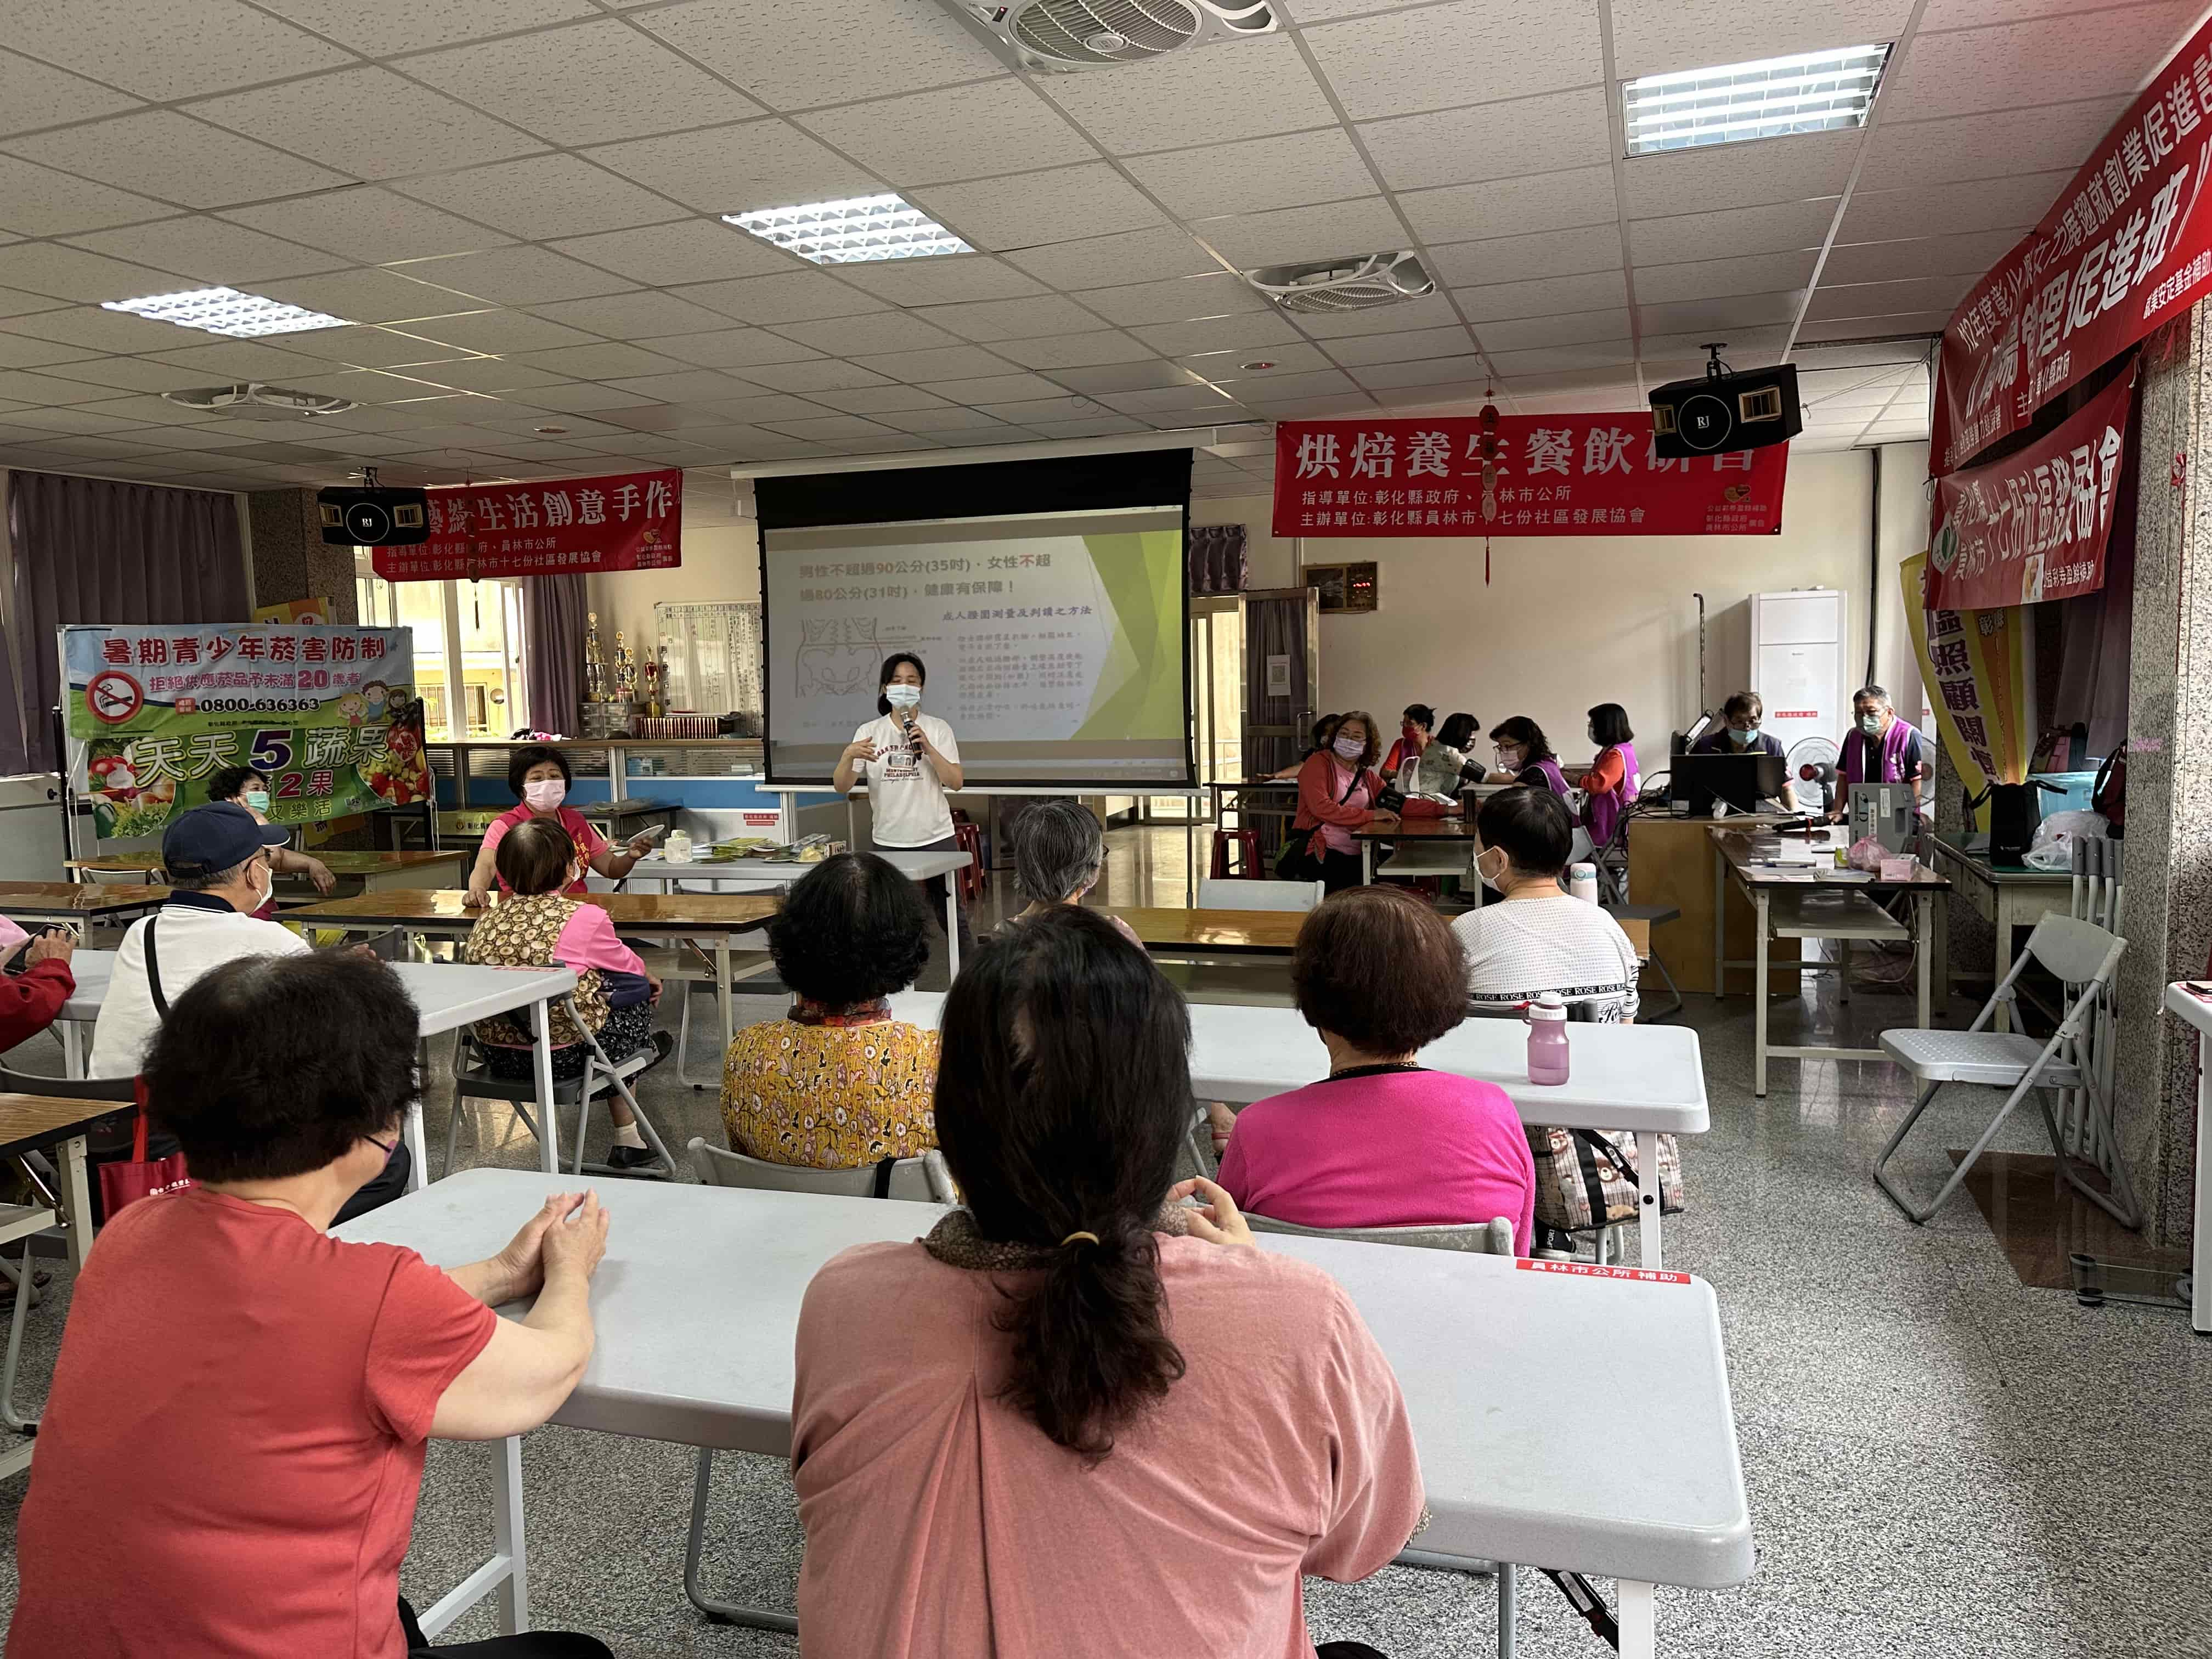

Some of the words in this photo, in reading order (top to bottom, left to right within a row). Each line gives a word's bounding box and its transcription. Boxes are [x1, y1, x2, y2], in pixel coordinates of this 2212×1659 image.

[2143, 248, 2212, 319] 業安定基金補助
[1697, 415, 1710, 428] RJ
[363, 518, 373, 527] RJ
[1300, 507, 1646, 527] 主辦單位:彰化縣員林市七份社區發展協會
[386, 537, 556, 557] 指導單位:彰化縣府、員林市公所
[2044, 560, 2095, 589] 益彩券盈餘補助
[103, 635, 386, 663] 暑期青少年菸害防制
[1925, 582, 1997, 781] 區照顧關懷
[201, 698, 320, 713] 0800-636363
[134, 724, 390, 788] 天天5蔬果
[268, 770, 334, 799] 2果
[1500, 992, 1525, 1000] ROSE
[1526, 991, 1542, 999] ROS
[1575, 986, 1597, 995] ROSE
[1598, 985, 1616, 993] ROSE
[1531, 1261, 1631, 1278] 員林市公所
[1638, 1271, 1678, 1282] 補助
